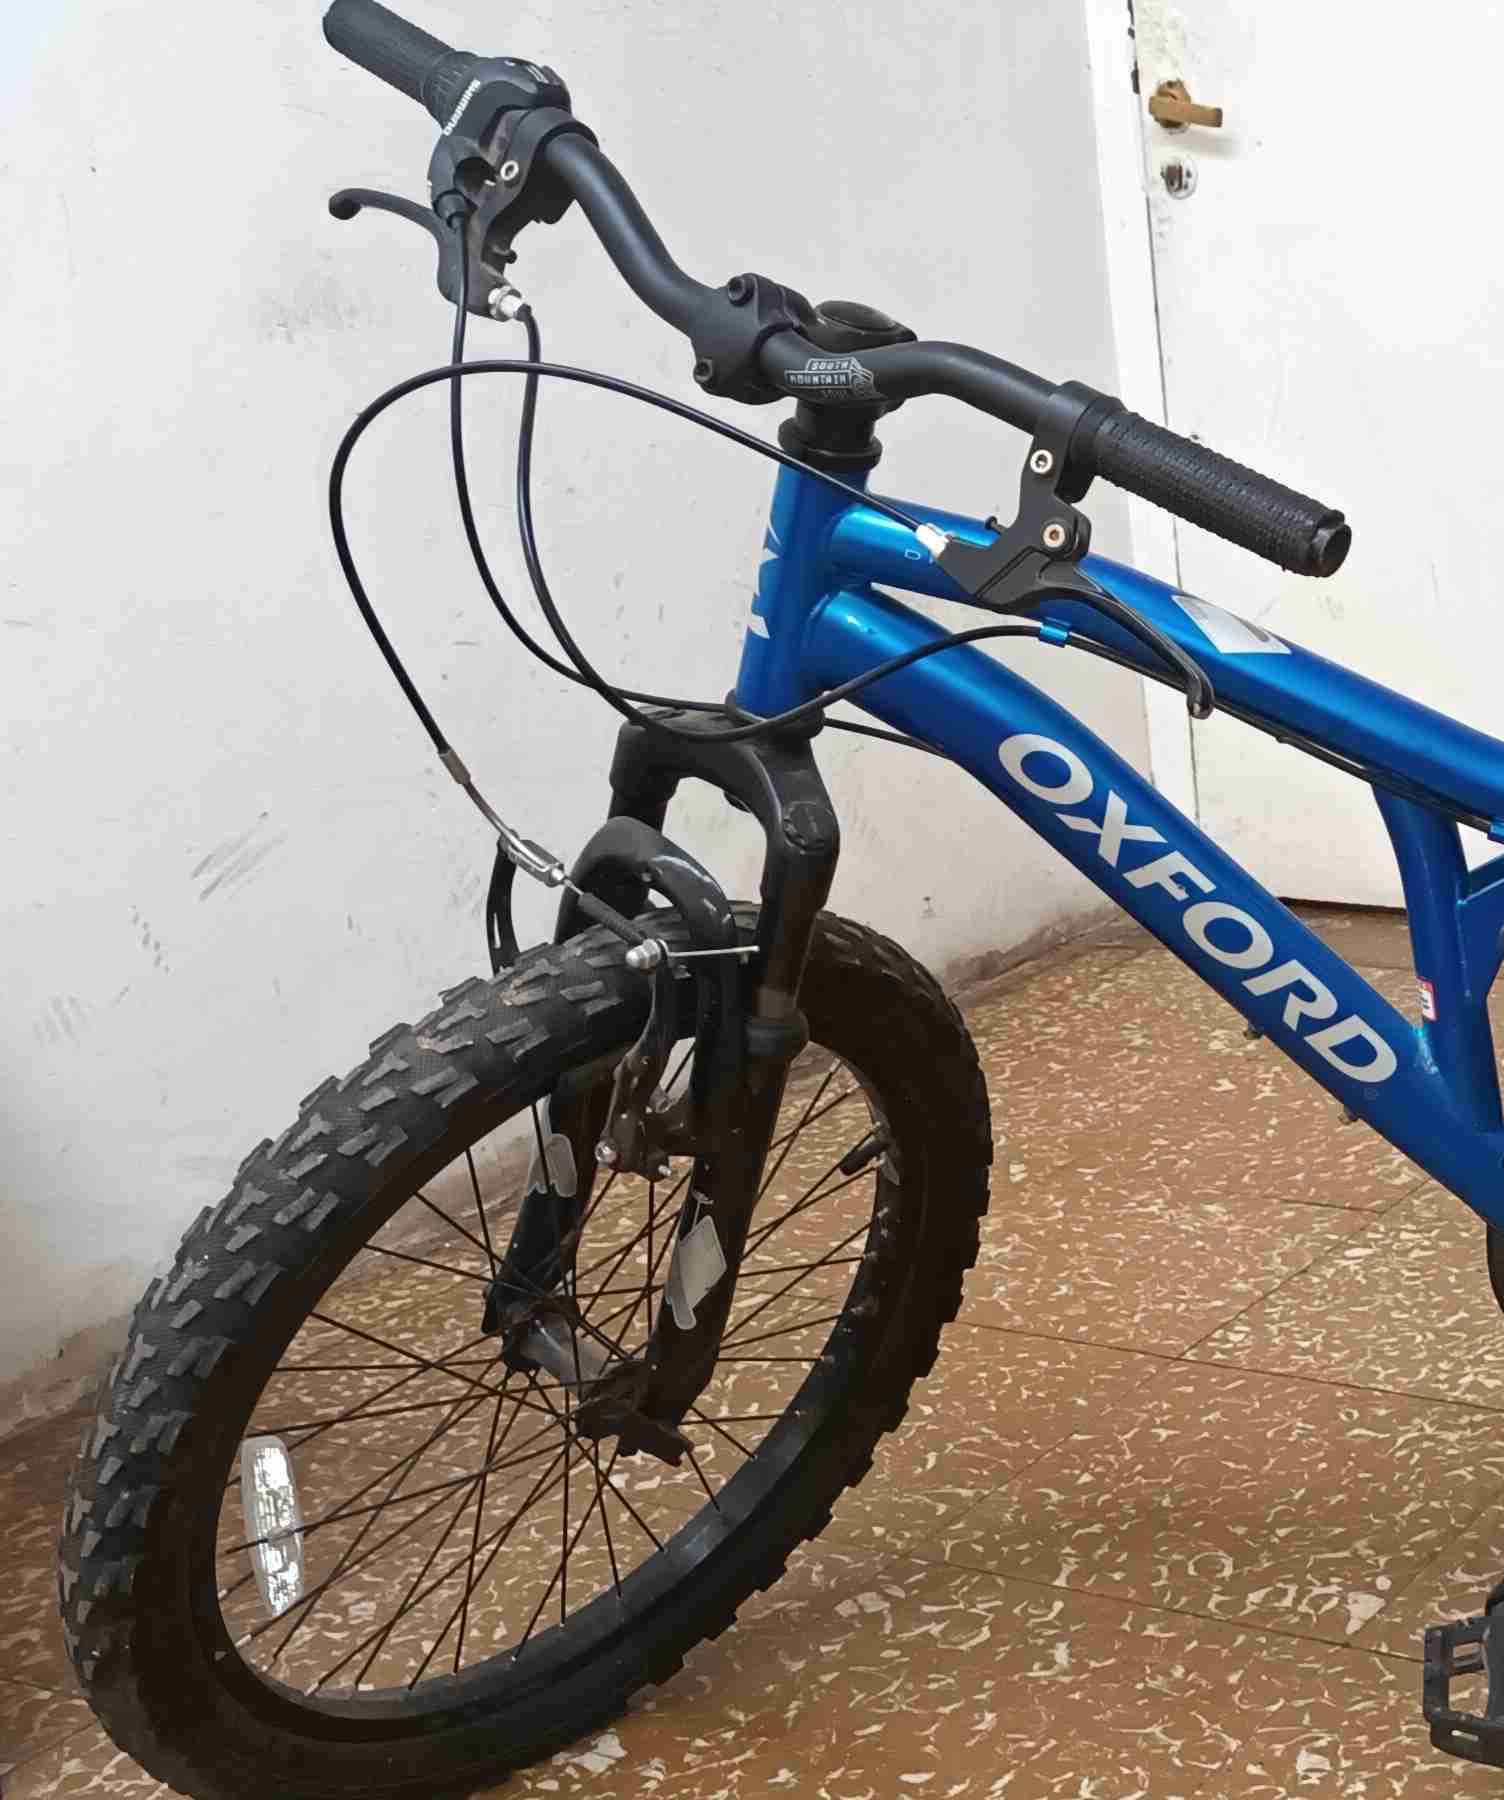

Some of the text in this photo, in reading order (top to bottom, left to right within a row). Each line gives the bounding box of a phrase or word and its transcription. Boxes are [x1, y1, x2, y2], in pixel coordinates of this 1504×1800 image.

[442, 78, 481, 136] SHIMANO
[789, 374, 848, 385] MOUNTAIN
[810, 361, 850, 371] SOUTH
[998, 734, 1398, 1082] OXFORD
